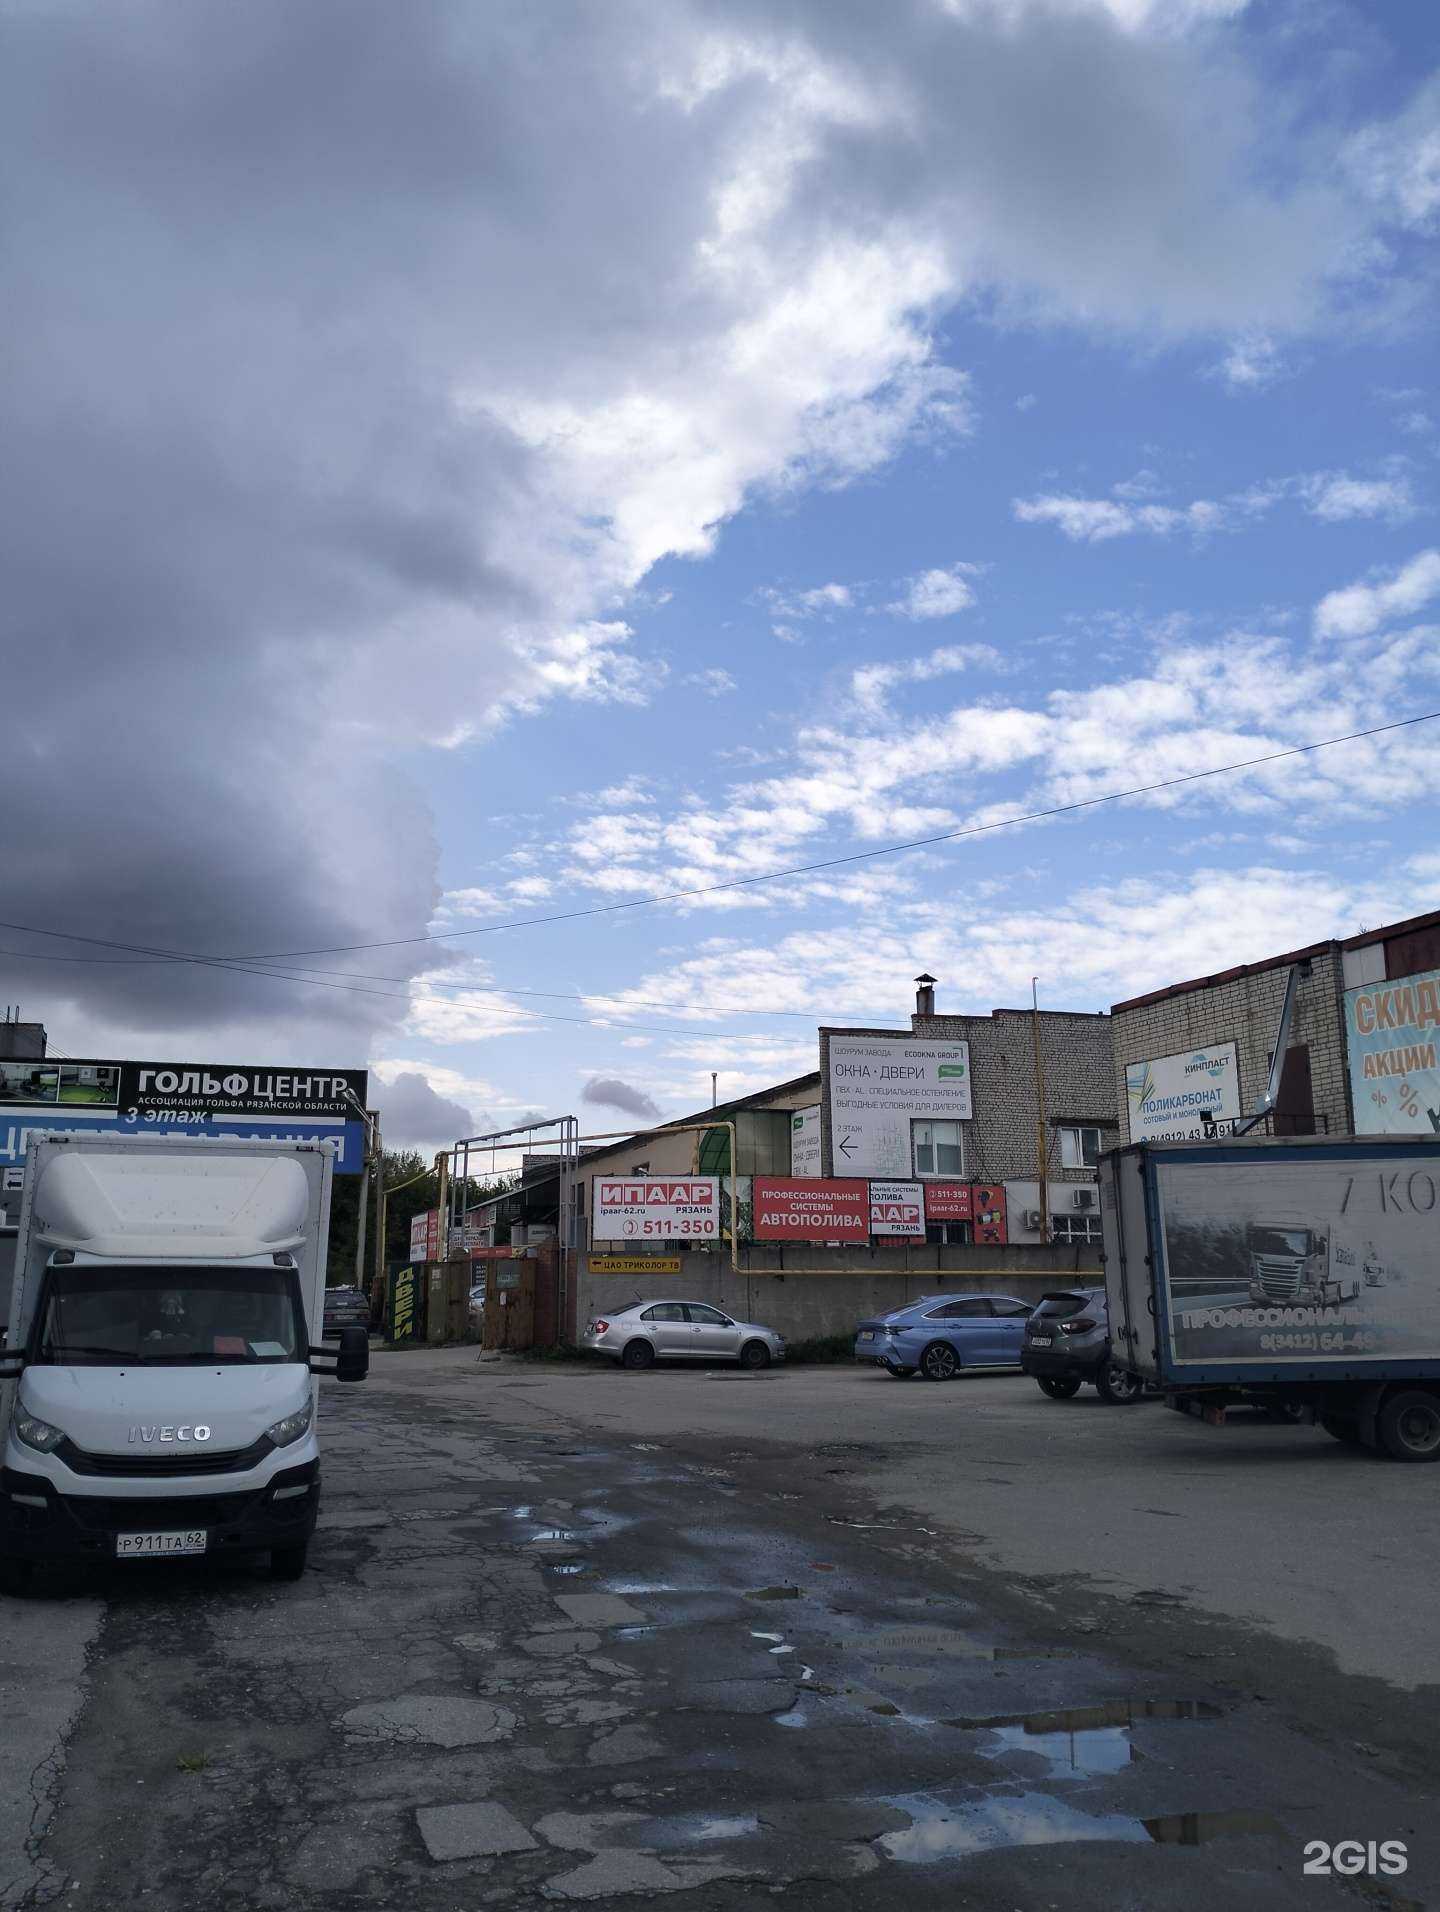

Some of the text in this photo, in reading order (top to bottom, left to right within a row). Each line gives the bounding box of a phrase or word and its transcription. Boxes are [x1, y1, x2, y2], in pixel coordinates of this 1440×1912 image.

[835, 1047, 891, 1057] ШОУРУМ ЗАВОДА
[1185, 1057, 1230, 1074] КИНПЛАСТ
[1364, 1044, 1435, 1079] АКЦИИ
[835, 1064, 871, 1078] ОКНА
[880, 1066, 925, 1080] ДВЕРИ
[138, 1070, 347, 1101] ГОЛЬФ ЦЕНТР
[138, 1097, 347, 1110] АССОЦИАЦИЯ ГОЛЬФА РЯЗАНСКОЙ ОБЛАСТИ
[836, 1100, 966, 1111] ВЫГОДНЫЕ УСЛОВИЯ ДЛЯ ДИЛЕРОВ
[1142, 1088, 1222, 1114] ПОЛИКАРБОНАТ
[125, 1107, 207, 1124] 3 этаж
[1143, 1113, 1172, 1125] СОТОВЫЙ
[1173, 1112, 1178, 1120] И
[843, 1125, 862, 1133] ЭТАЖ
[601, 1184, 713, 1205] ИПААР
[762, 1191, 861, 1201] ПРОФЕССИОНАЛЬНЫЕ
[937, 1191, 968, 1199] 511-350
[600, 1207, 646, 1216] ipaar-62.ru
[790, 1203, 833, 1211] СИСТЕМЫ
[930, 1205, 968, 1213] ipaar-62.ru
[643, 1220, 714, 1234] 511-350
[760, 1214, 862, 1227] АВТОПОЛИВА
[624, 1262, 667, 1270] ТРИКОЛОР
[394, 1266, 414, 1340] ДВЕРИ
[128, 1425, 211, 1442] IVECO
[123, 1532, 202, 1551] Р911ТА 62
